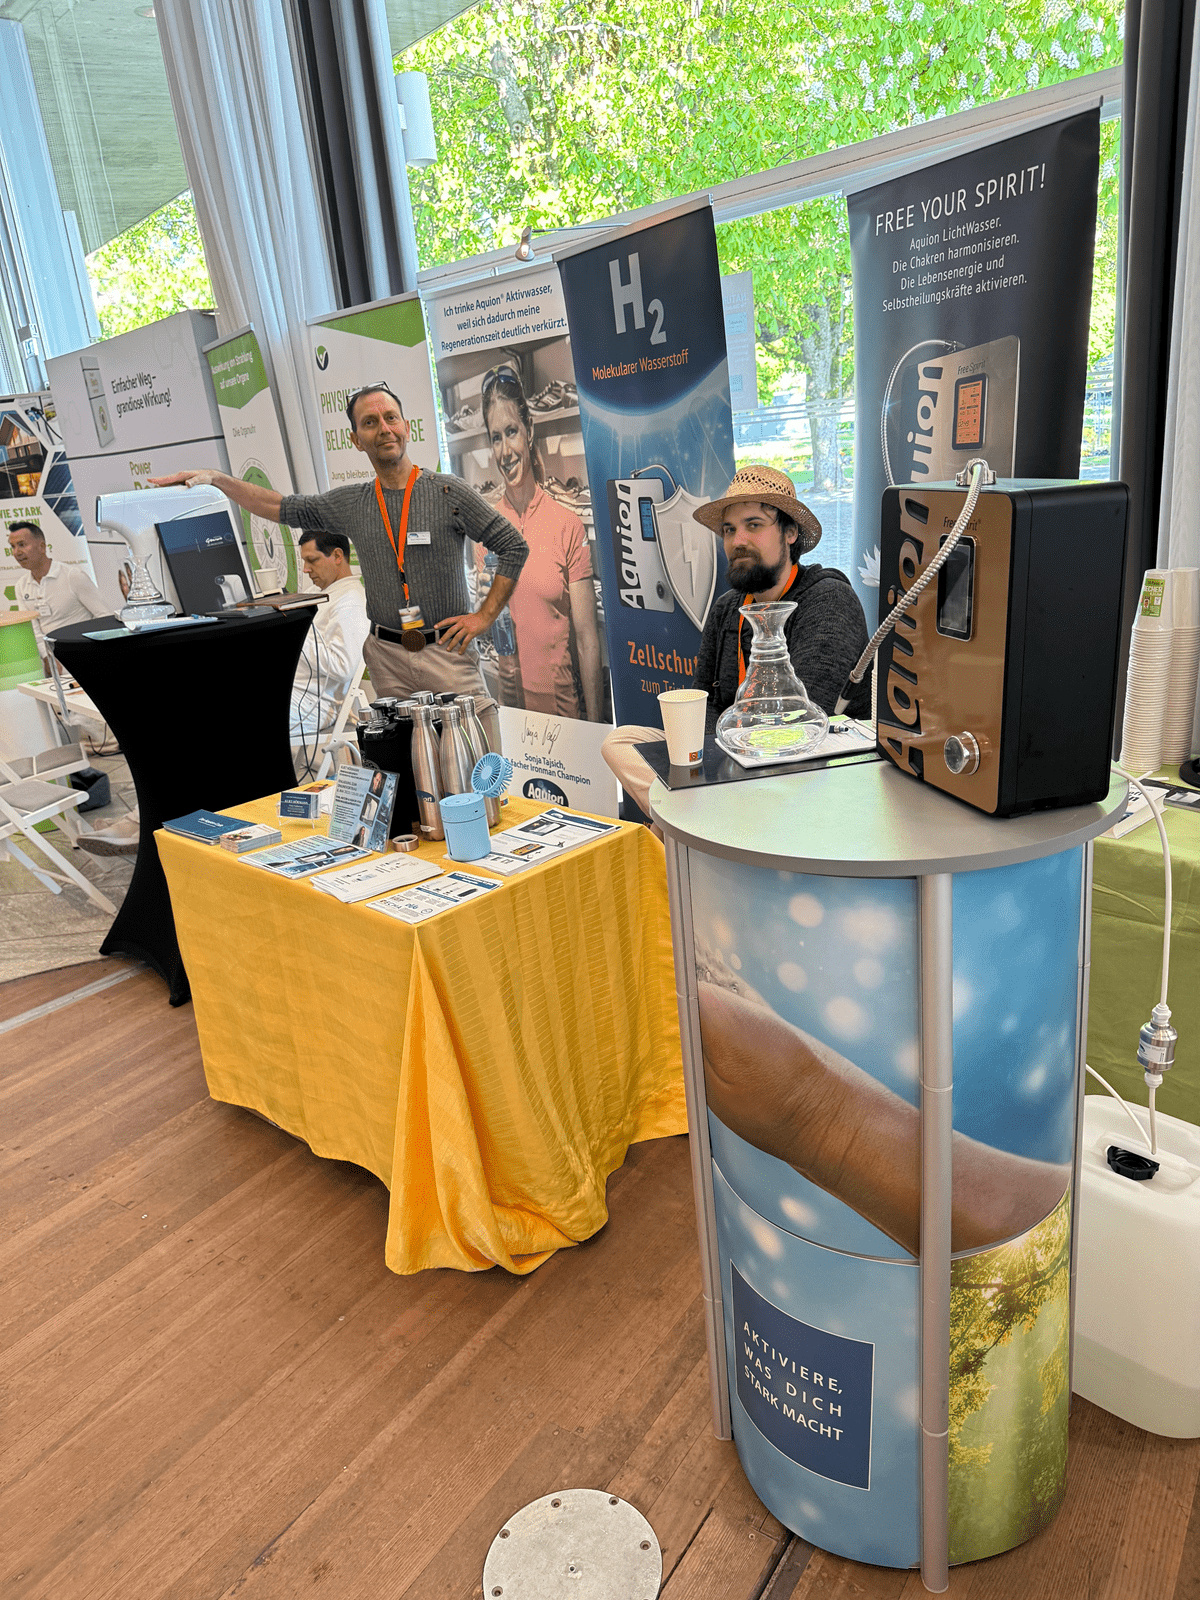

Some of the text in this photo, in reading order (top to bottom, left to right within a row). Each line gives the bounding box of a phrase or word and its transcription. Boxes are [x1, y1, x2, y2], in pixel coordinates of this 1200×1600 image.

[875, 163, 1046, 236] FREE YOUR SPIRIT!
[909, 216, 1002, 251] Aquion LichtWasser.
[892, 233, 1020, 274] Die Chakren harmonisieren.
[900, 254, 1005, 290] Die Lebensenergie und
[443, 307, 454, 317] Ich
[454, 302, 474, 315] trinke
[505, 284, 553, 303] Aktivwasser,
[882, 272, 1028, 312] Selbstheilungskräfte aktivieren.
[441, 317, 567, 352] Regenerationszeit deutlich verkürzt.
[457, 305, 541, 331] weil sich dadurch meine
[592, 348, 689, 381] Molekularer Wasserstoff
[111, 375, 138, 394] Einfacher
[137, 371, 153, 389] Weg
[116, 388, 172, 418] grandiose Wirkung!
[129, 461, 152, 476] Power
[331, 471, 345, 481] Jung
[346, 468, 370, 479] bleiben
[12, 506, 42, 518] STARK
[615, 480, 645, 609] Aquion
[641, 679, 660, 694] zum
[524, 752, 566, 770] Sonja Tajsich,
[530, 763, 557, 777] Ironman
[557, 771, 591, 785] Champion
[743, 1321, 843, 1394] AKTIVIERE,
[743, 1342, 842, 1417] WAS DICH
[743, 1365, 844, 1441] STARK MACHT
